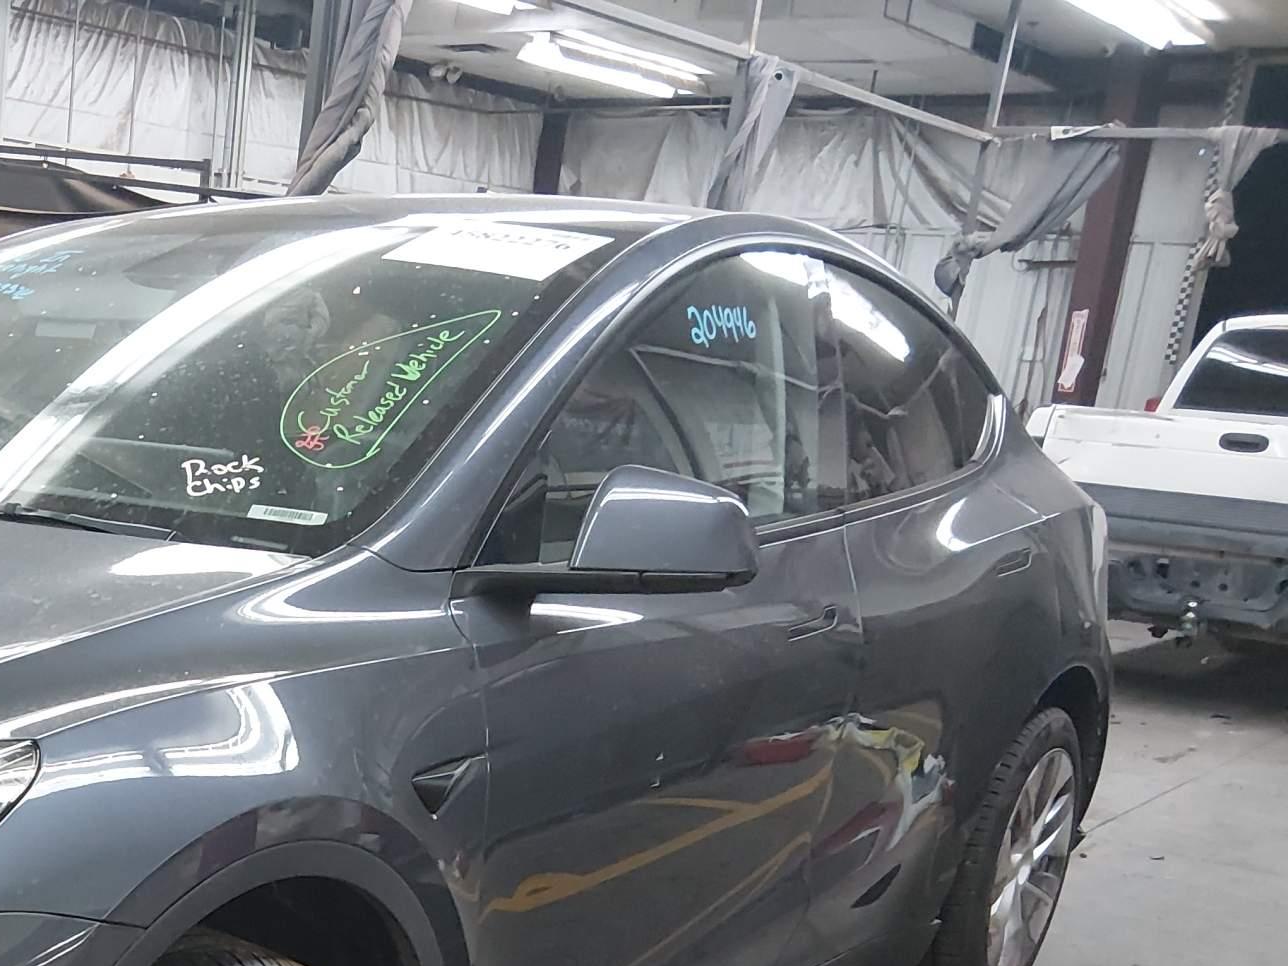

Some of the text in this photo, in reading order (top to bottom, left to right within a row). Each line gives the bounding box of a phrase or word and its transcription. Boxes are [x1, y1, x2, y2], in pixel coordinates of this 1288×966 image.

[687, 306, 755, 346] 204946
[333, 381, 407, 445] Released
[391, 329, 465, 382] Vehicle
[181, 454, 264, 480] Rock
